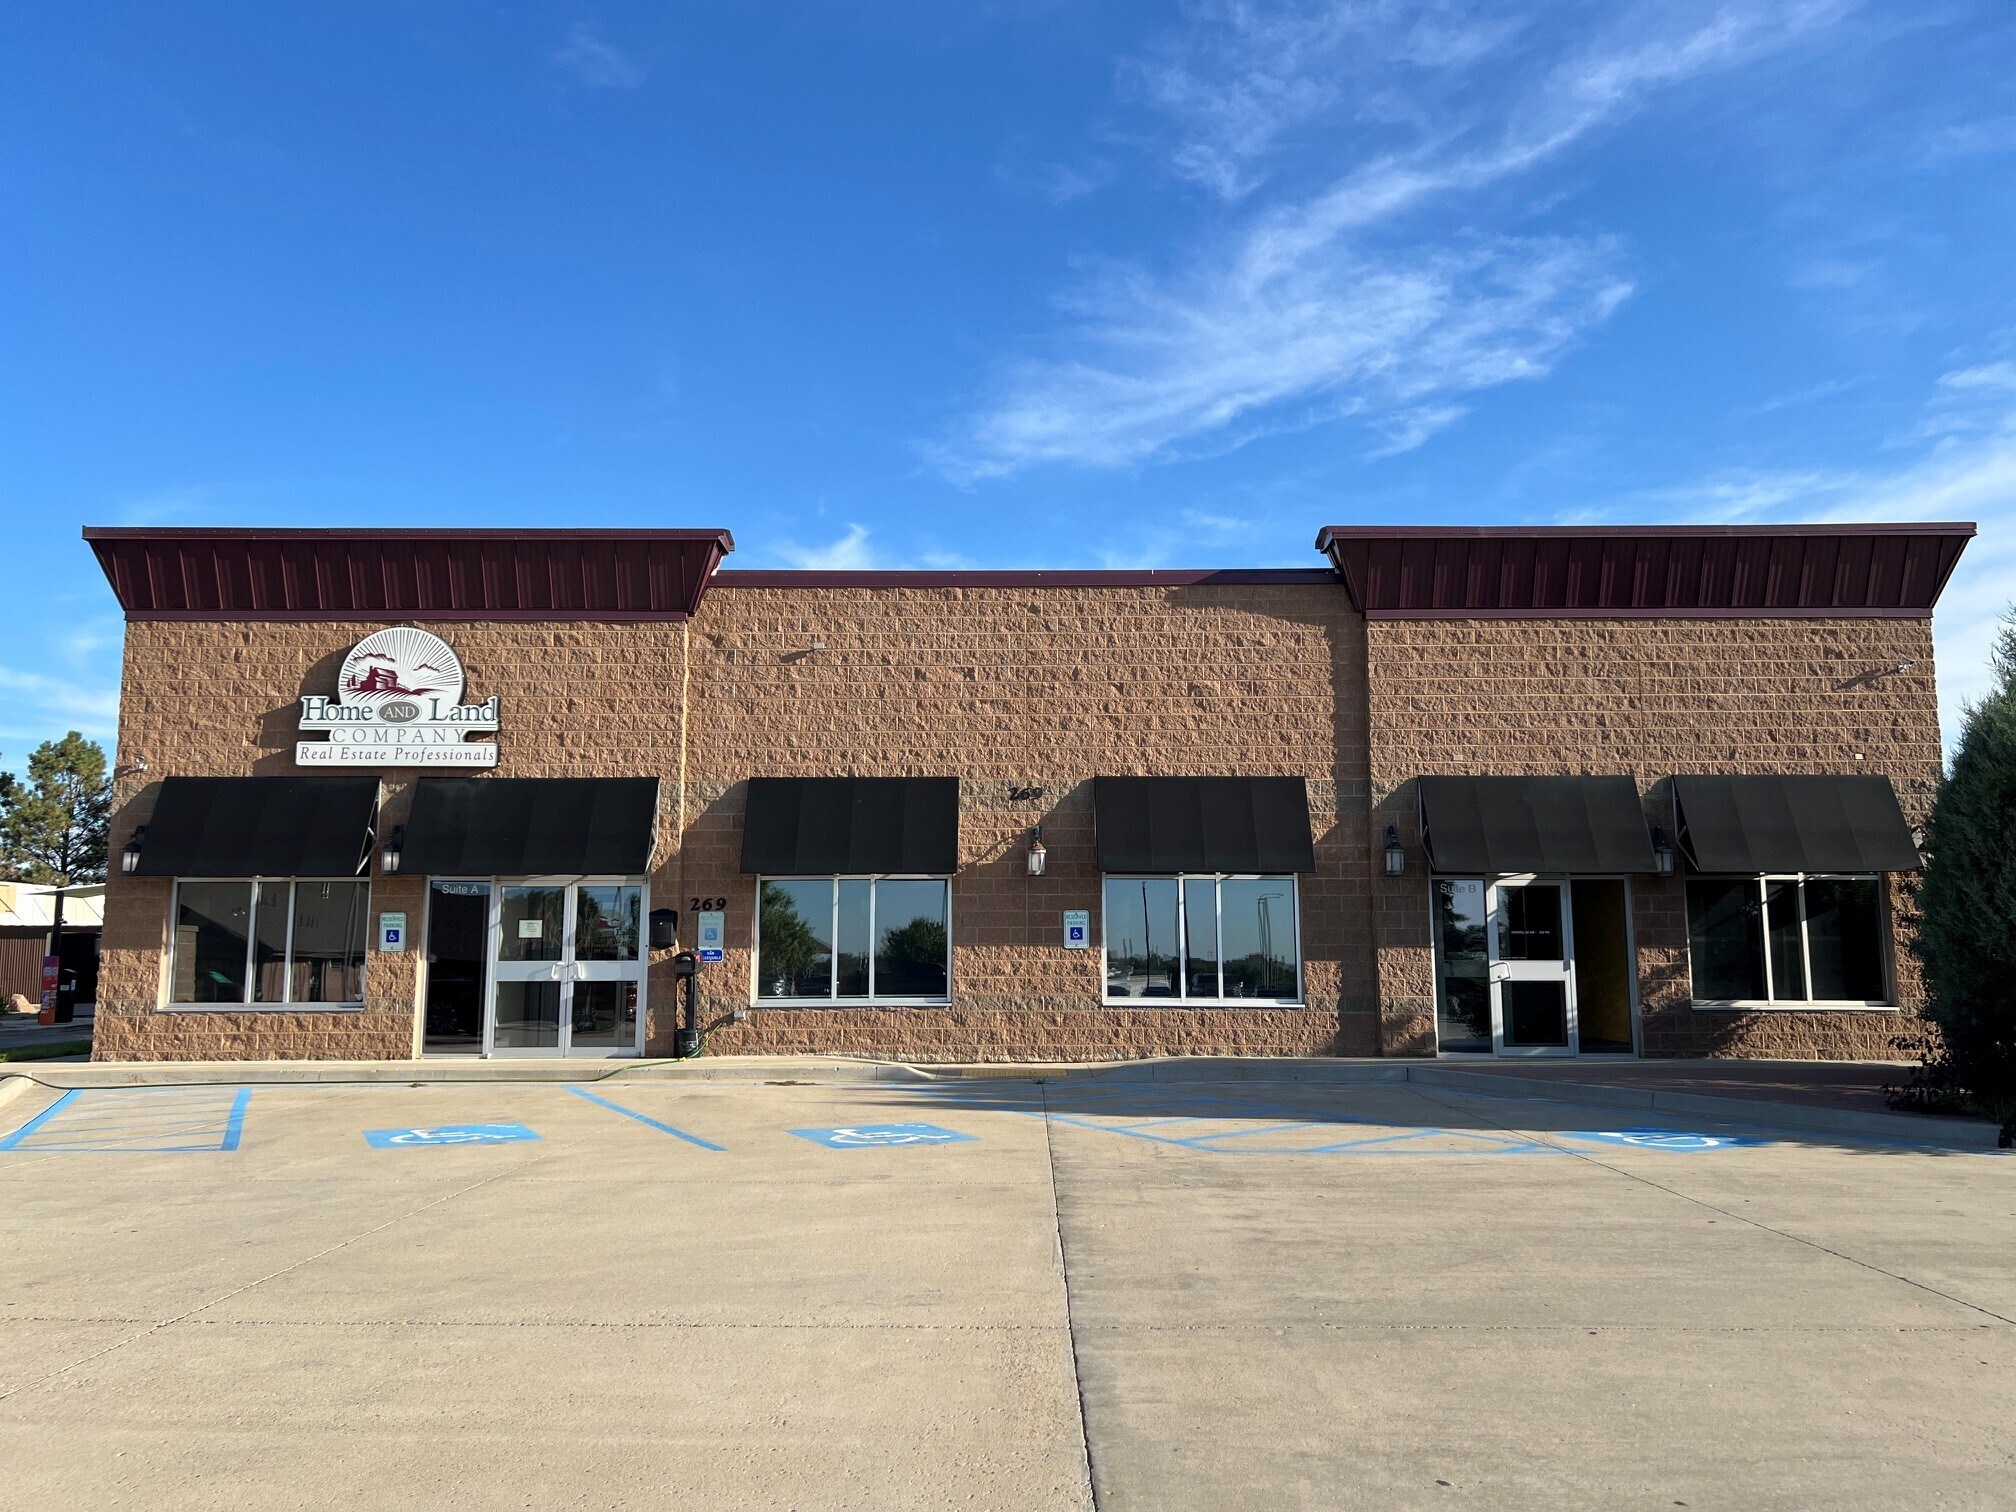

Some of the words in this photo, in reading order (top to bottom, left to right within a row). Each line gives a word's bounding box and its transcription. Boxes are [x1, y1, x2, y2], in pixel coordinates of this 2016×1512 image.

[303, 698, 373, 721] Home
[383, 706, 415, 718] AND
[428, 698, 498, 721] Land
[332, 728, 466, 743] COMPANY
[300, 747, 333, 760] Real
[340, 747, 387, 760] Estate
[395, 747, 494, 763] Professionals
[1008, 786, 1043, 800] 269
[441, 884, 468, 894] Suite
[470, 884, 479, 894] A
[1439, 883, 1466, 894] Suite
[1468, 884, 1477, 894] B
[690, 897, 727, 911] 269
